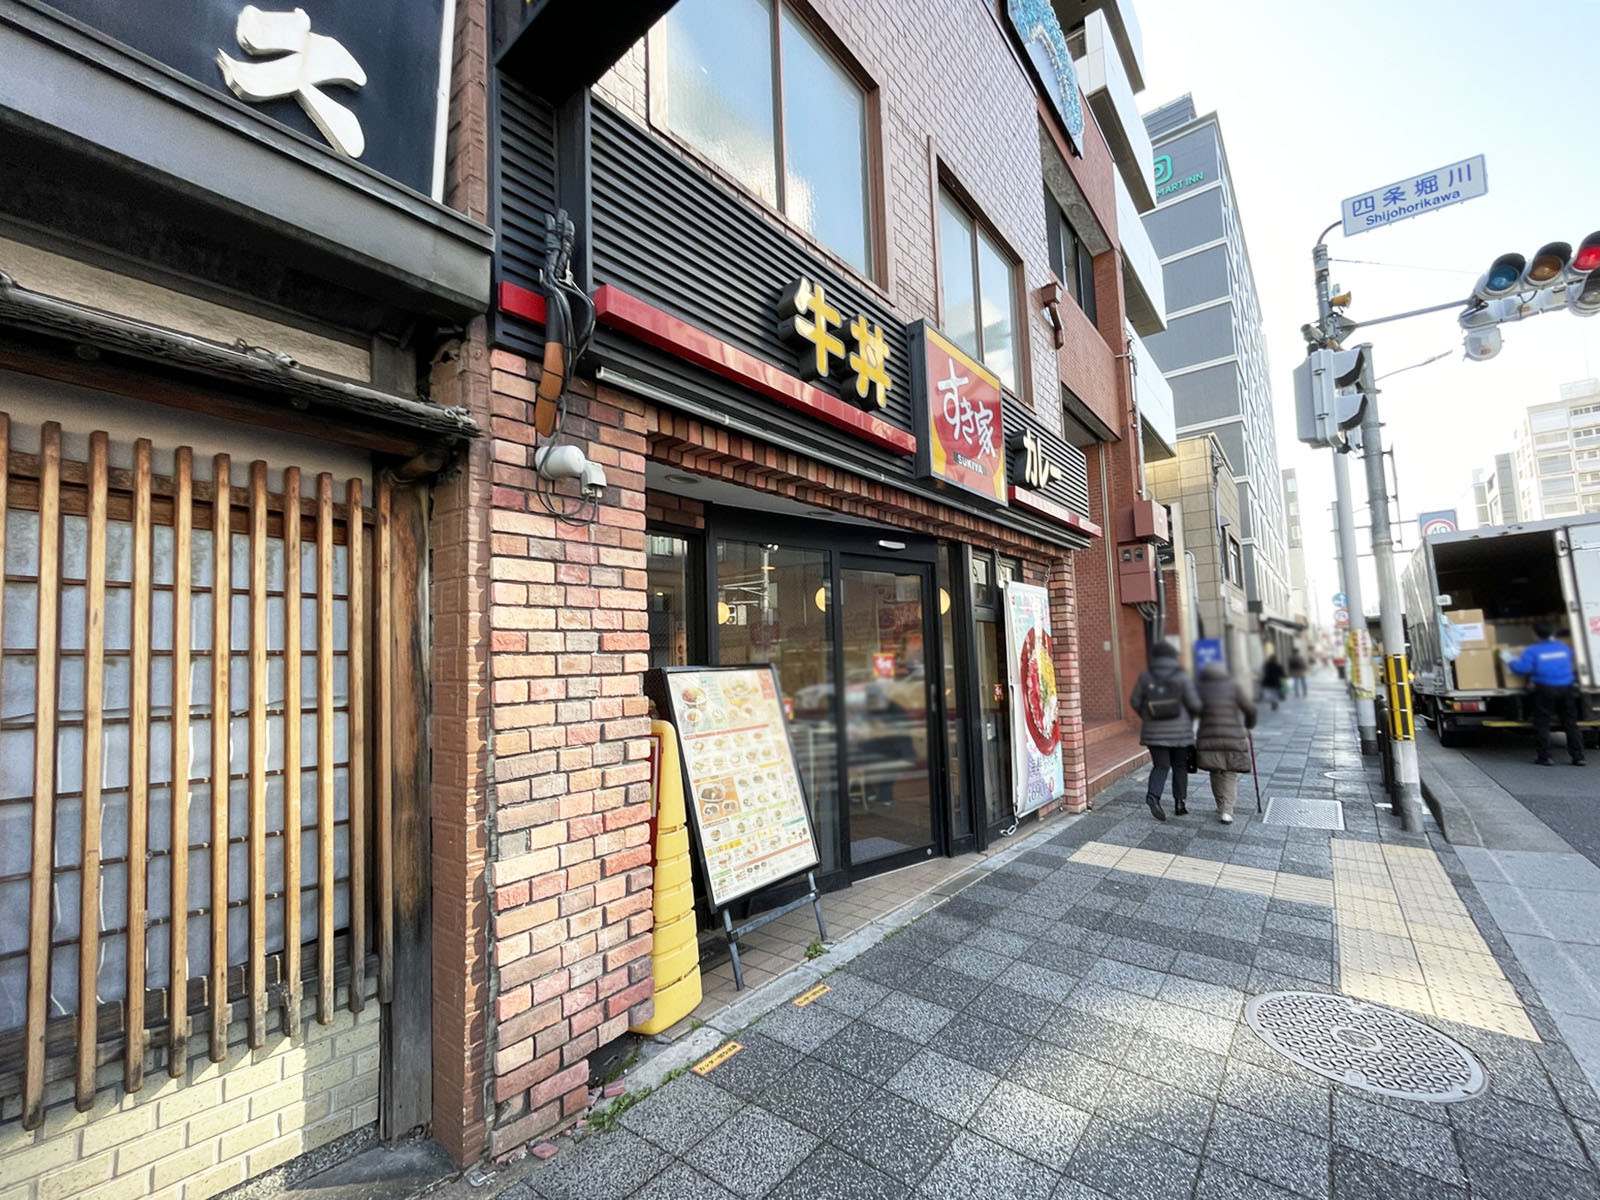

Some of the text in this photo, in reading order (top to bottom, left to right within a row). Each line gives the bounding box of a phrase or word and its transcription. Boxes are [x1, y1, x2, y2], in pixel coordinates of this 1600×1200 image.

[1186, 172, 1204, 186] INN
[1352, 164, 1471, 217] 四条堀川
[1366, 190, 1460, 225] Shijohorikawa
[794, 276, 892, 408] 牛丼
[937, 358, 996, 459] すき家
[957, 454, 983, 475] SUKIYA
[1023, 429, 1062, 488] カレー
